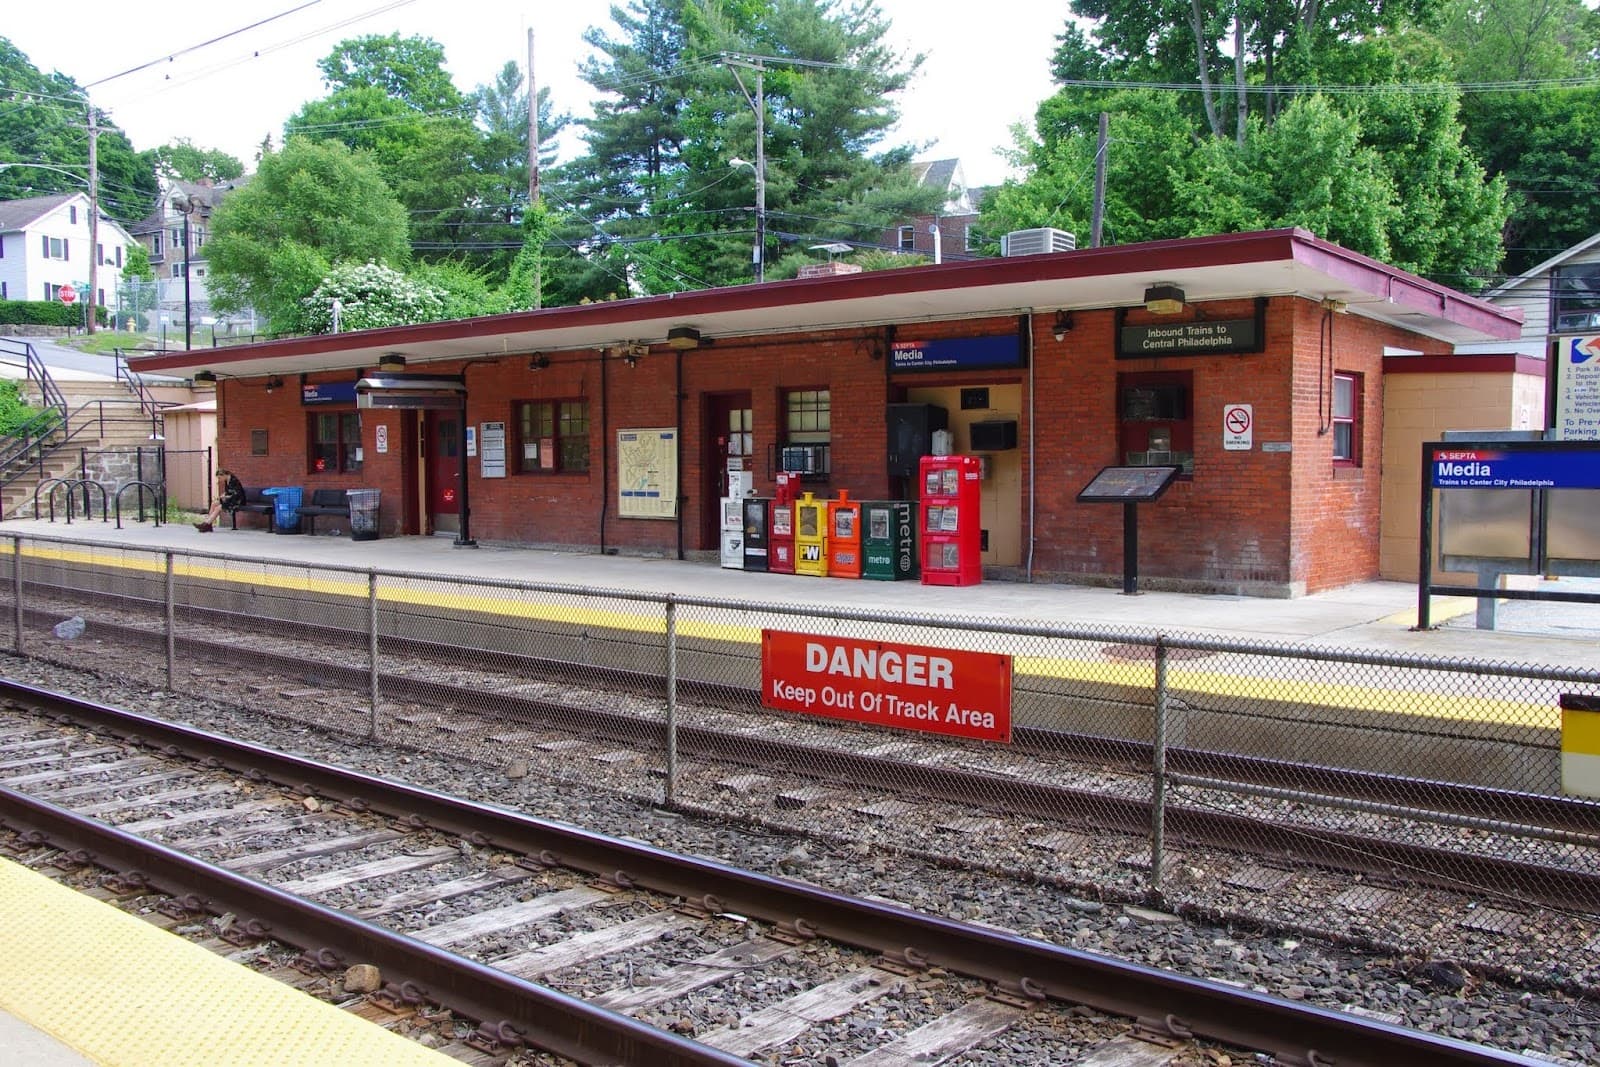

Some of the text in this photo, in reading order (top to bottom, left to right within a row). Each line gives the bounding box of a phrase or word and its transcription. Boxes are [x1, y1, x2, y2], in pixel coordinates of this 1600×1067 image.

[60, 290, 75, 298] STOP
[1147, 325, 1227, 338] Inbound Trains to
[1142, 336, 1233, 349] Central Philadelphia
[895, 349, 923, 360] Media
[1564, 428, 1598, 436] Parking
[1449, 452, 1476, 460] SEPTA
[1438, 462, 1491, 476] Media
[1494, 479, 1508, 487] City
[1509, 479, 1554, 487] Philadelphia
[800, 545, 819, 560] PW
[868, 555, 890, 565] metro
[806, 642, 953, 690] DANGER
[773, 680, 995, 729] Keep Out Of Track Area
